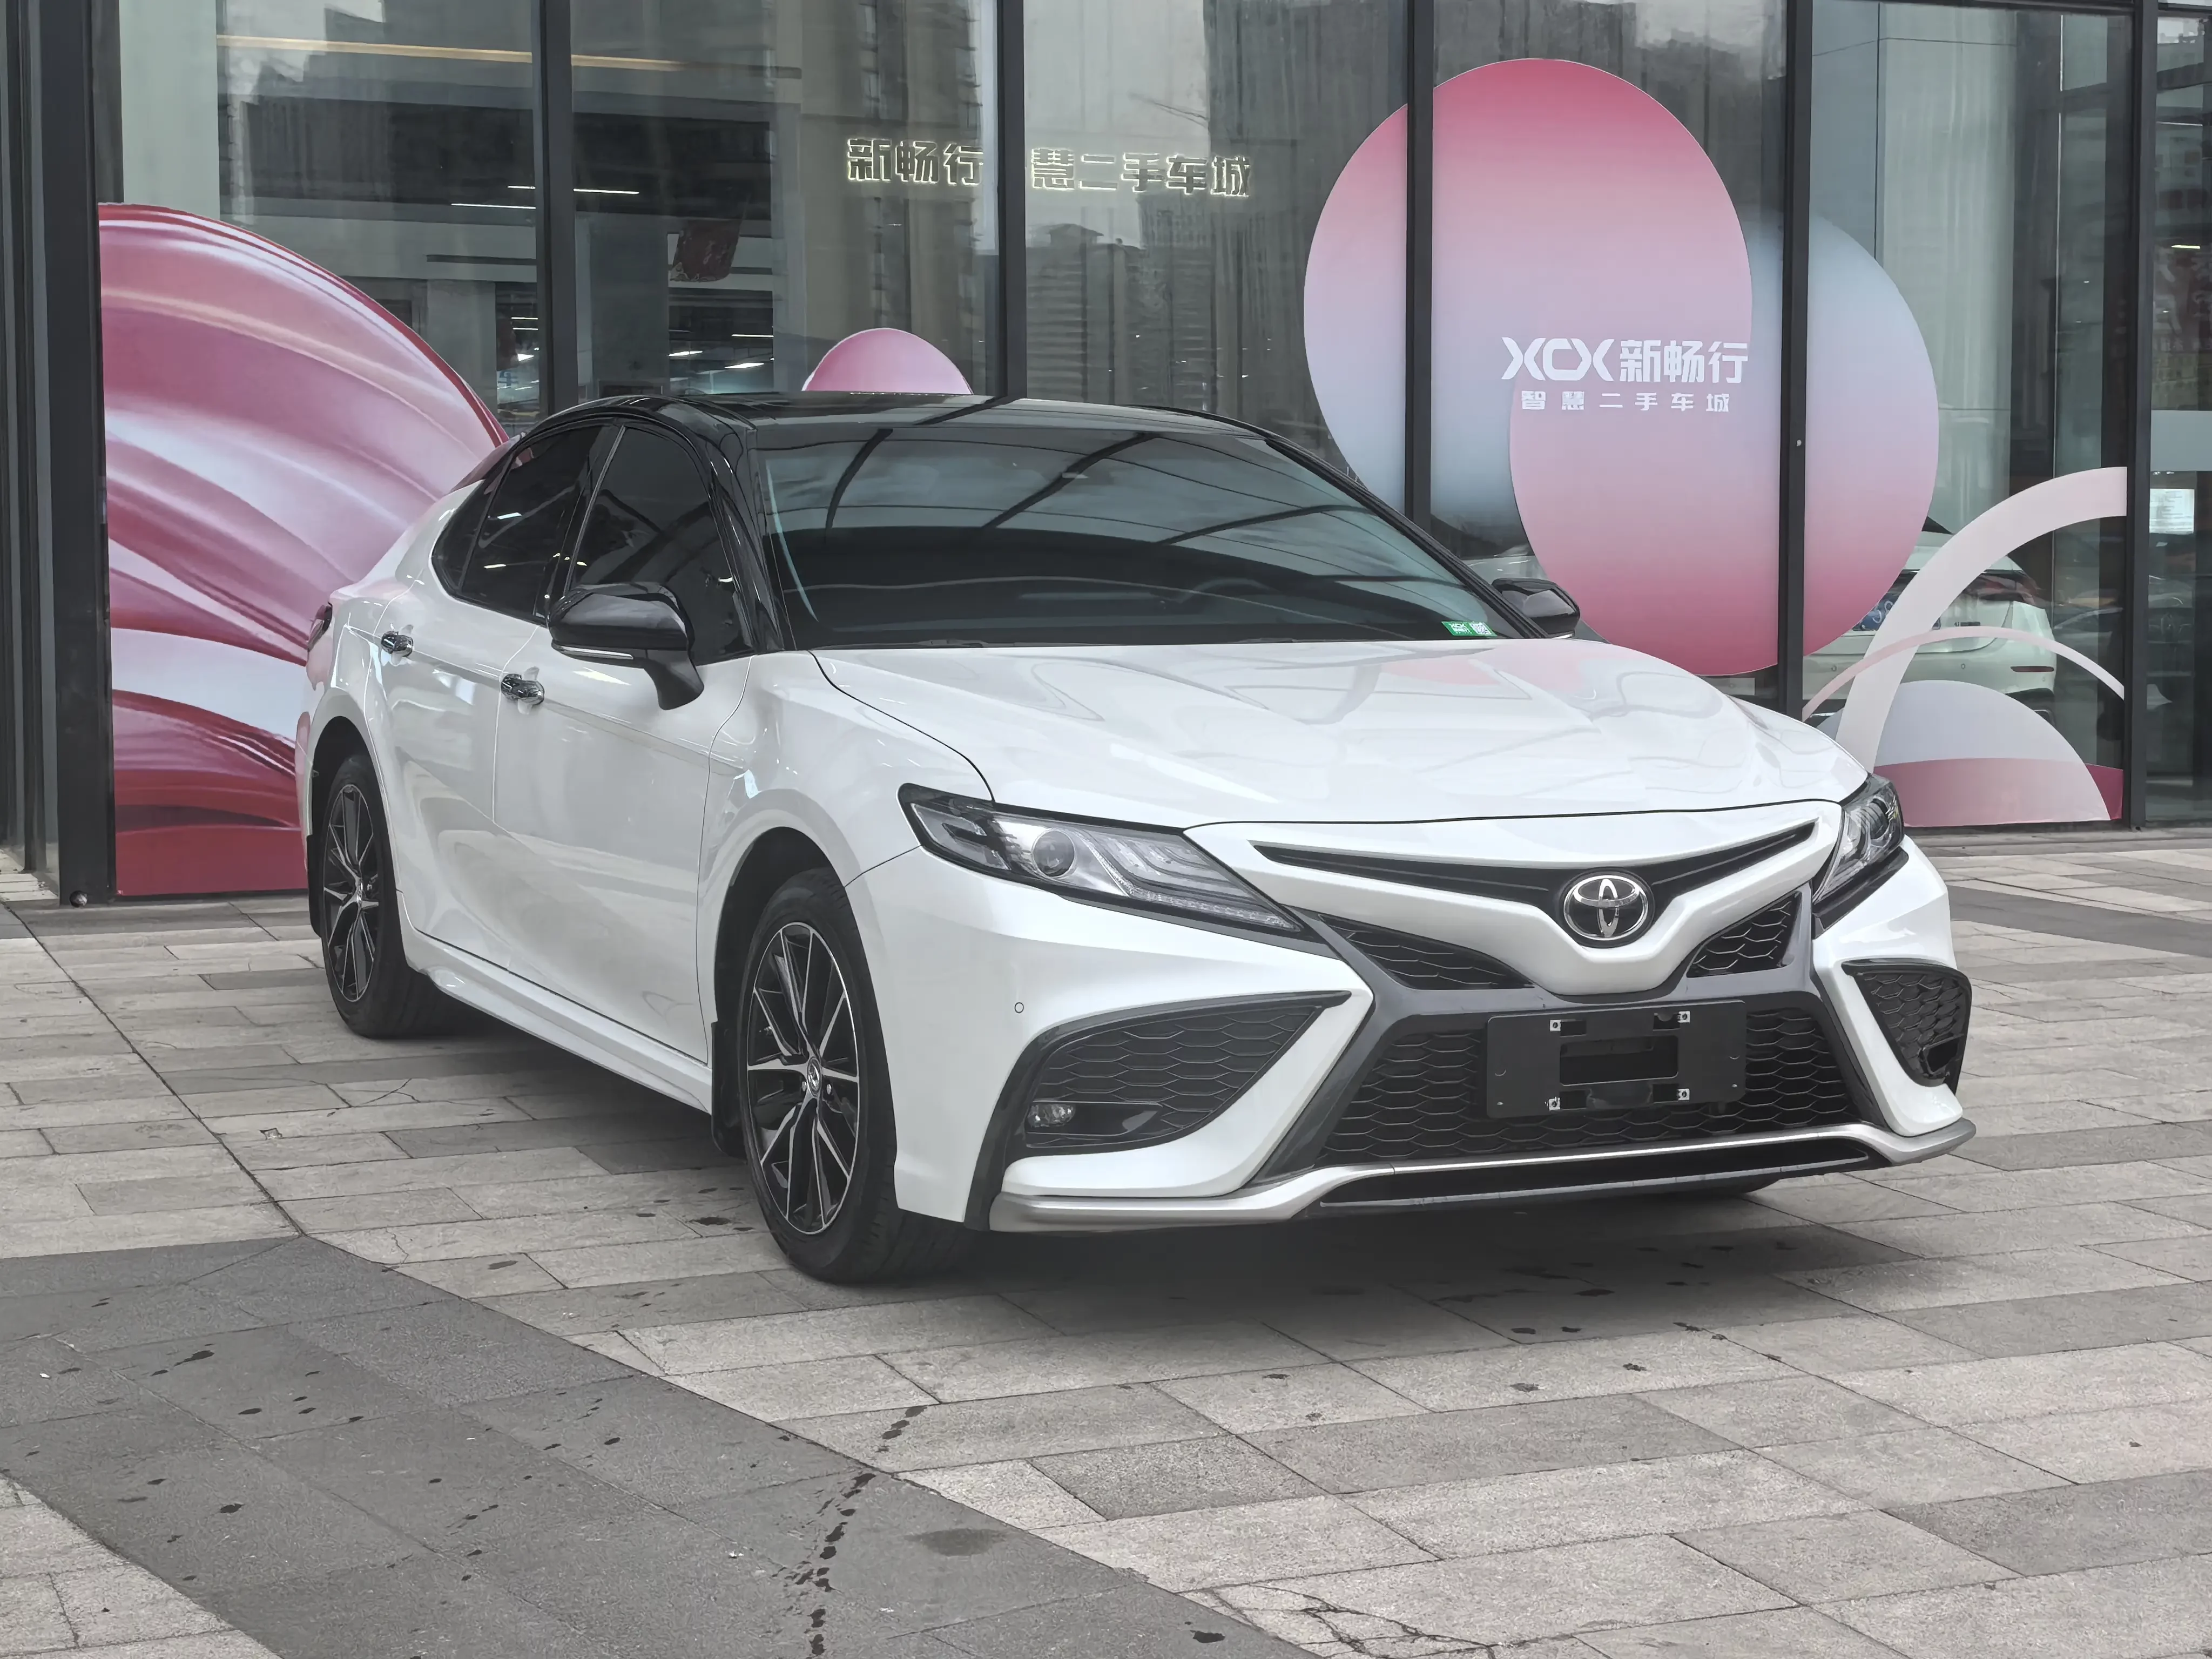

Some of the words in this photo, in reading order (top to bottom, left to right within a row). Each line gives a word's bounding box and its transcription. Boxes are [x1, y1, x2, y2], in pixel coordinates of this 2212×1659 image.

[847, 138, 984, 185] 新畅行
[1620, 339, 1749, 383] 新畅行
[1521, 390, 1730, 413] 智慧二手车城
